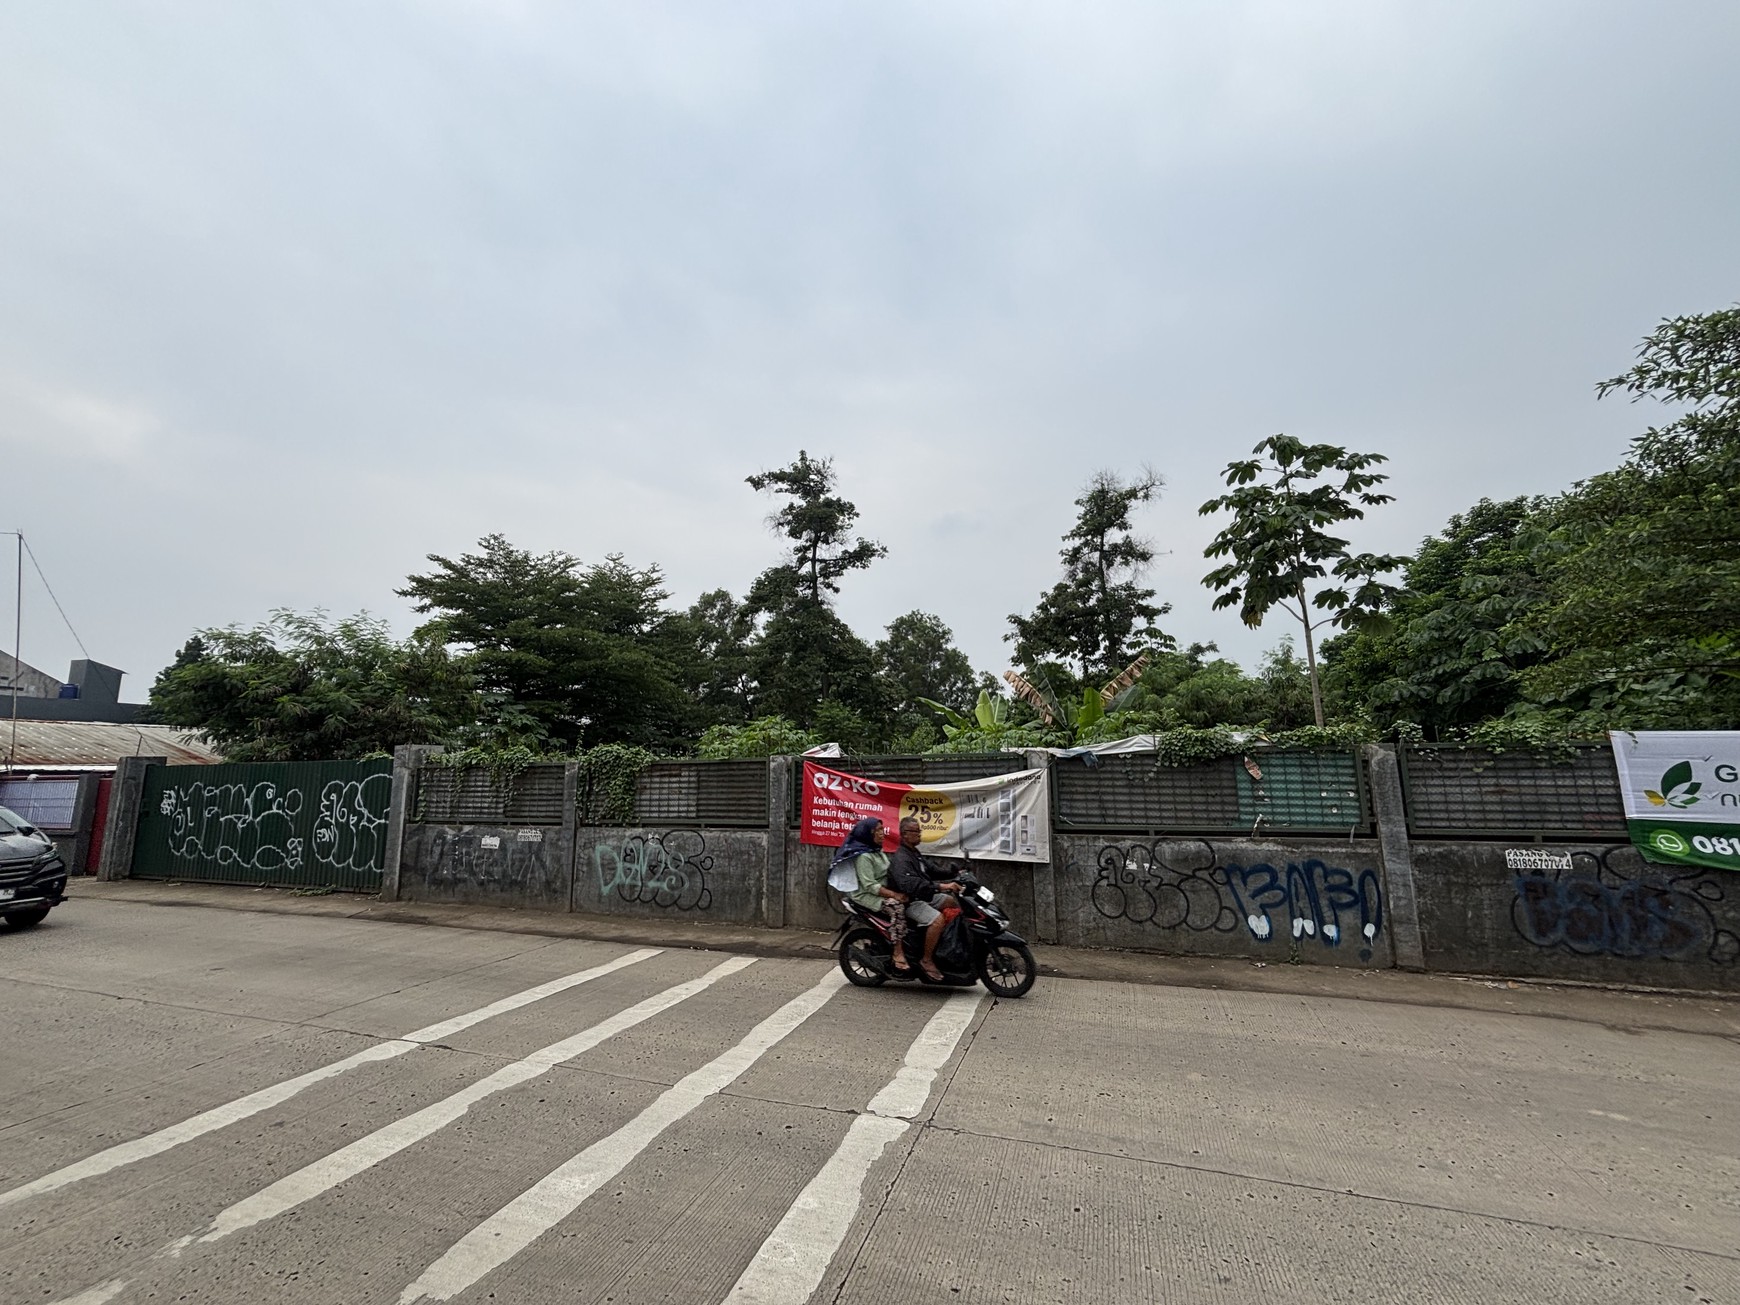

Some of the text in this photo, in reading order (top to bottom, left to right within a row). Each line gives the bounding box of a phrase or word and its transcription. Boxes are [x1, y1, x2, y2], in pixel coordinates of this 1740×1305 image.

[813, 796, 883, 812] Kebutuhan rumah
[906, 796, 944, 805] Cashback
[812, 808, 836, 818] makin
[811, 818, 840, 830] belanja
